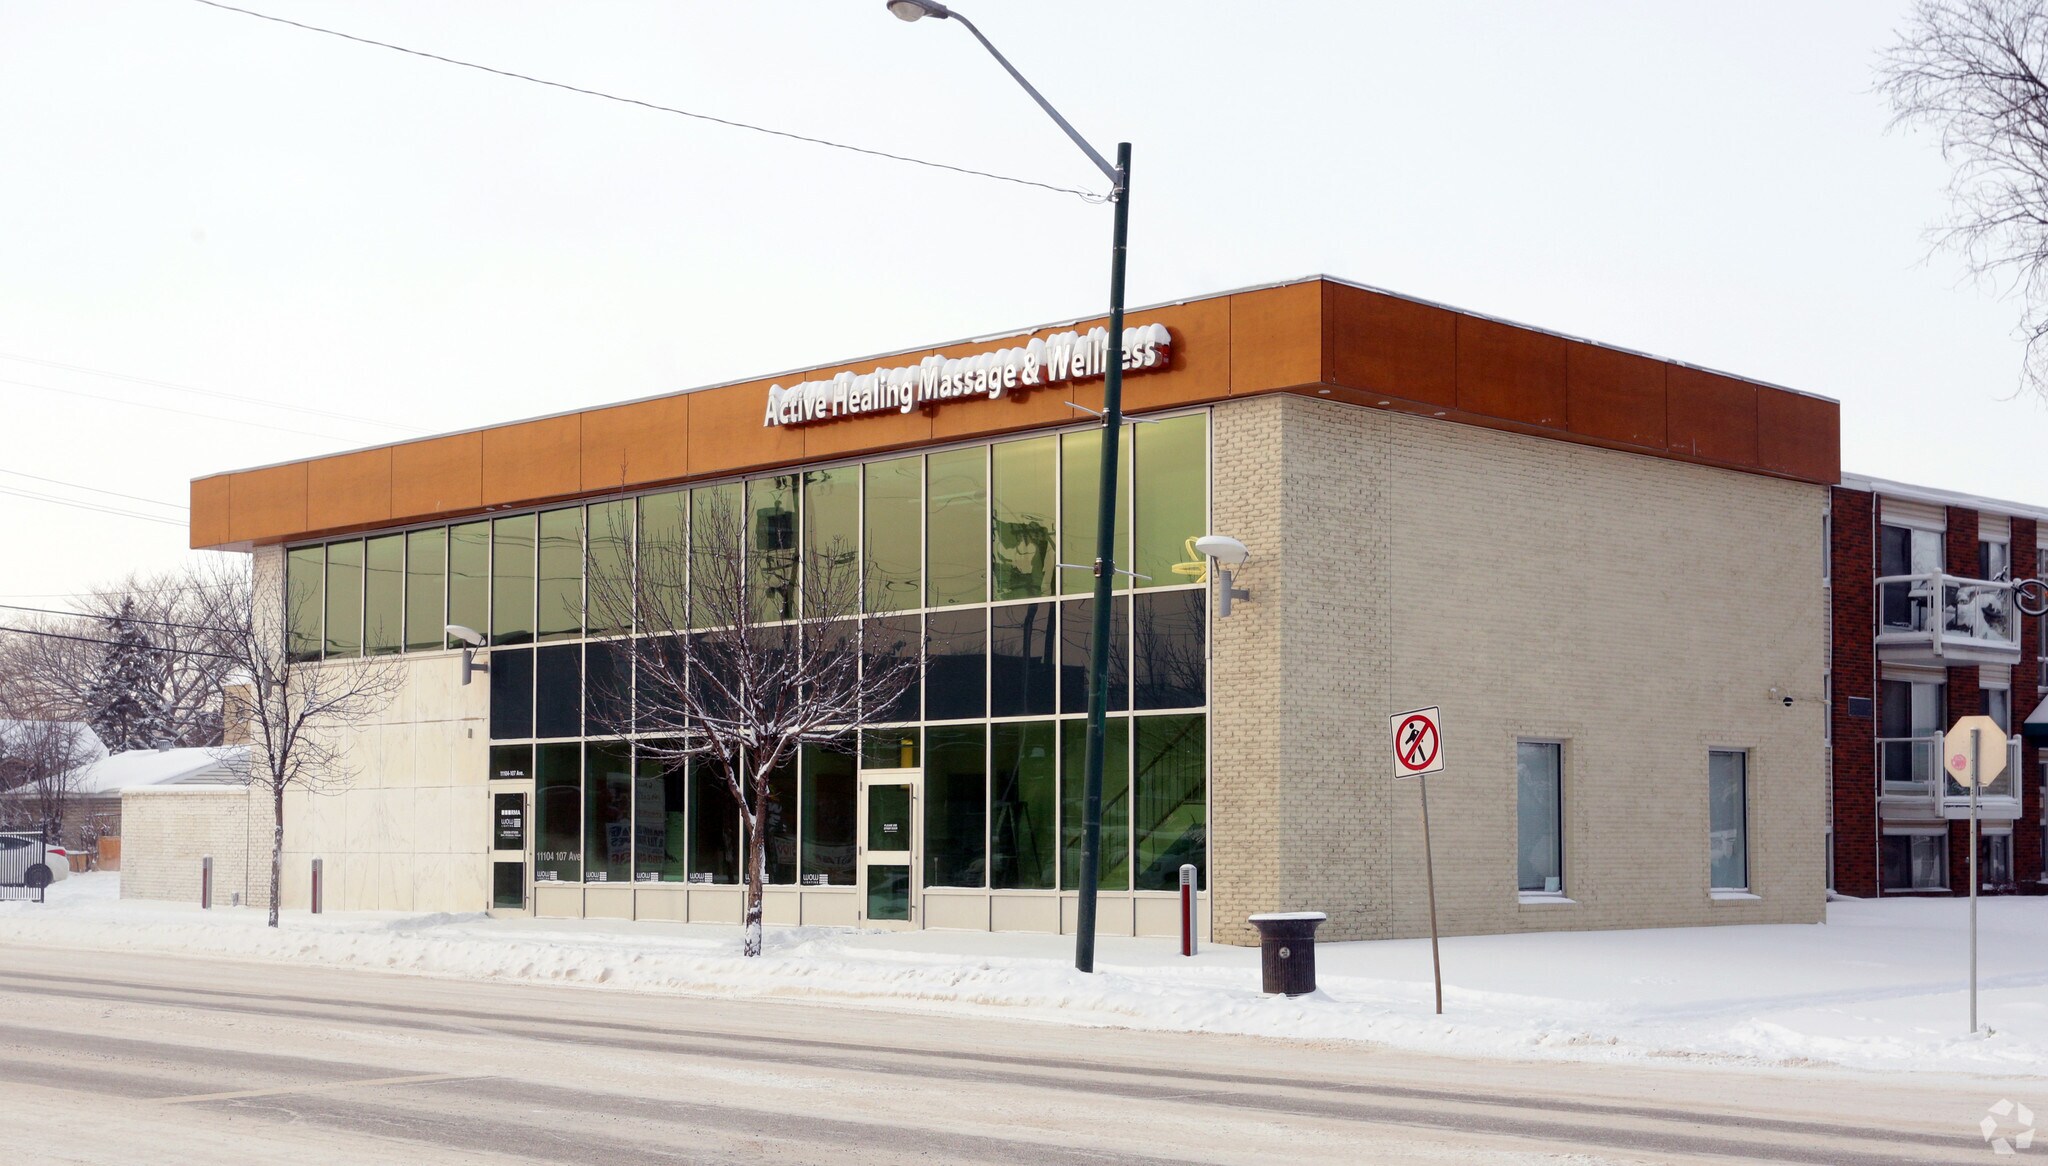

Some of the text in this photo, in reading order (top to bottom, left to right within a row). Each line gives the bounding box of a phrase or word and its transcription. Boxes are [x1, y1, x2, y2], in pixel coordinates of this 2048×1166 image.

[763, 392, 828, 427] Active
[832, 374, 914, 414] Healing
[917, 361, 1018, 402] Massage
[1021, 350, 1041, 386] &
[556, 851, 567, 861] 107
